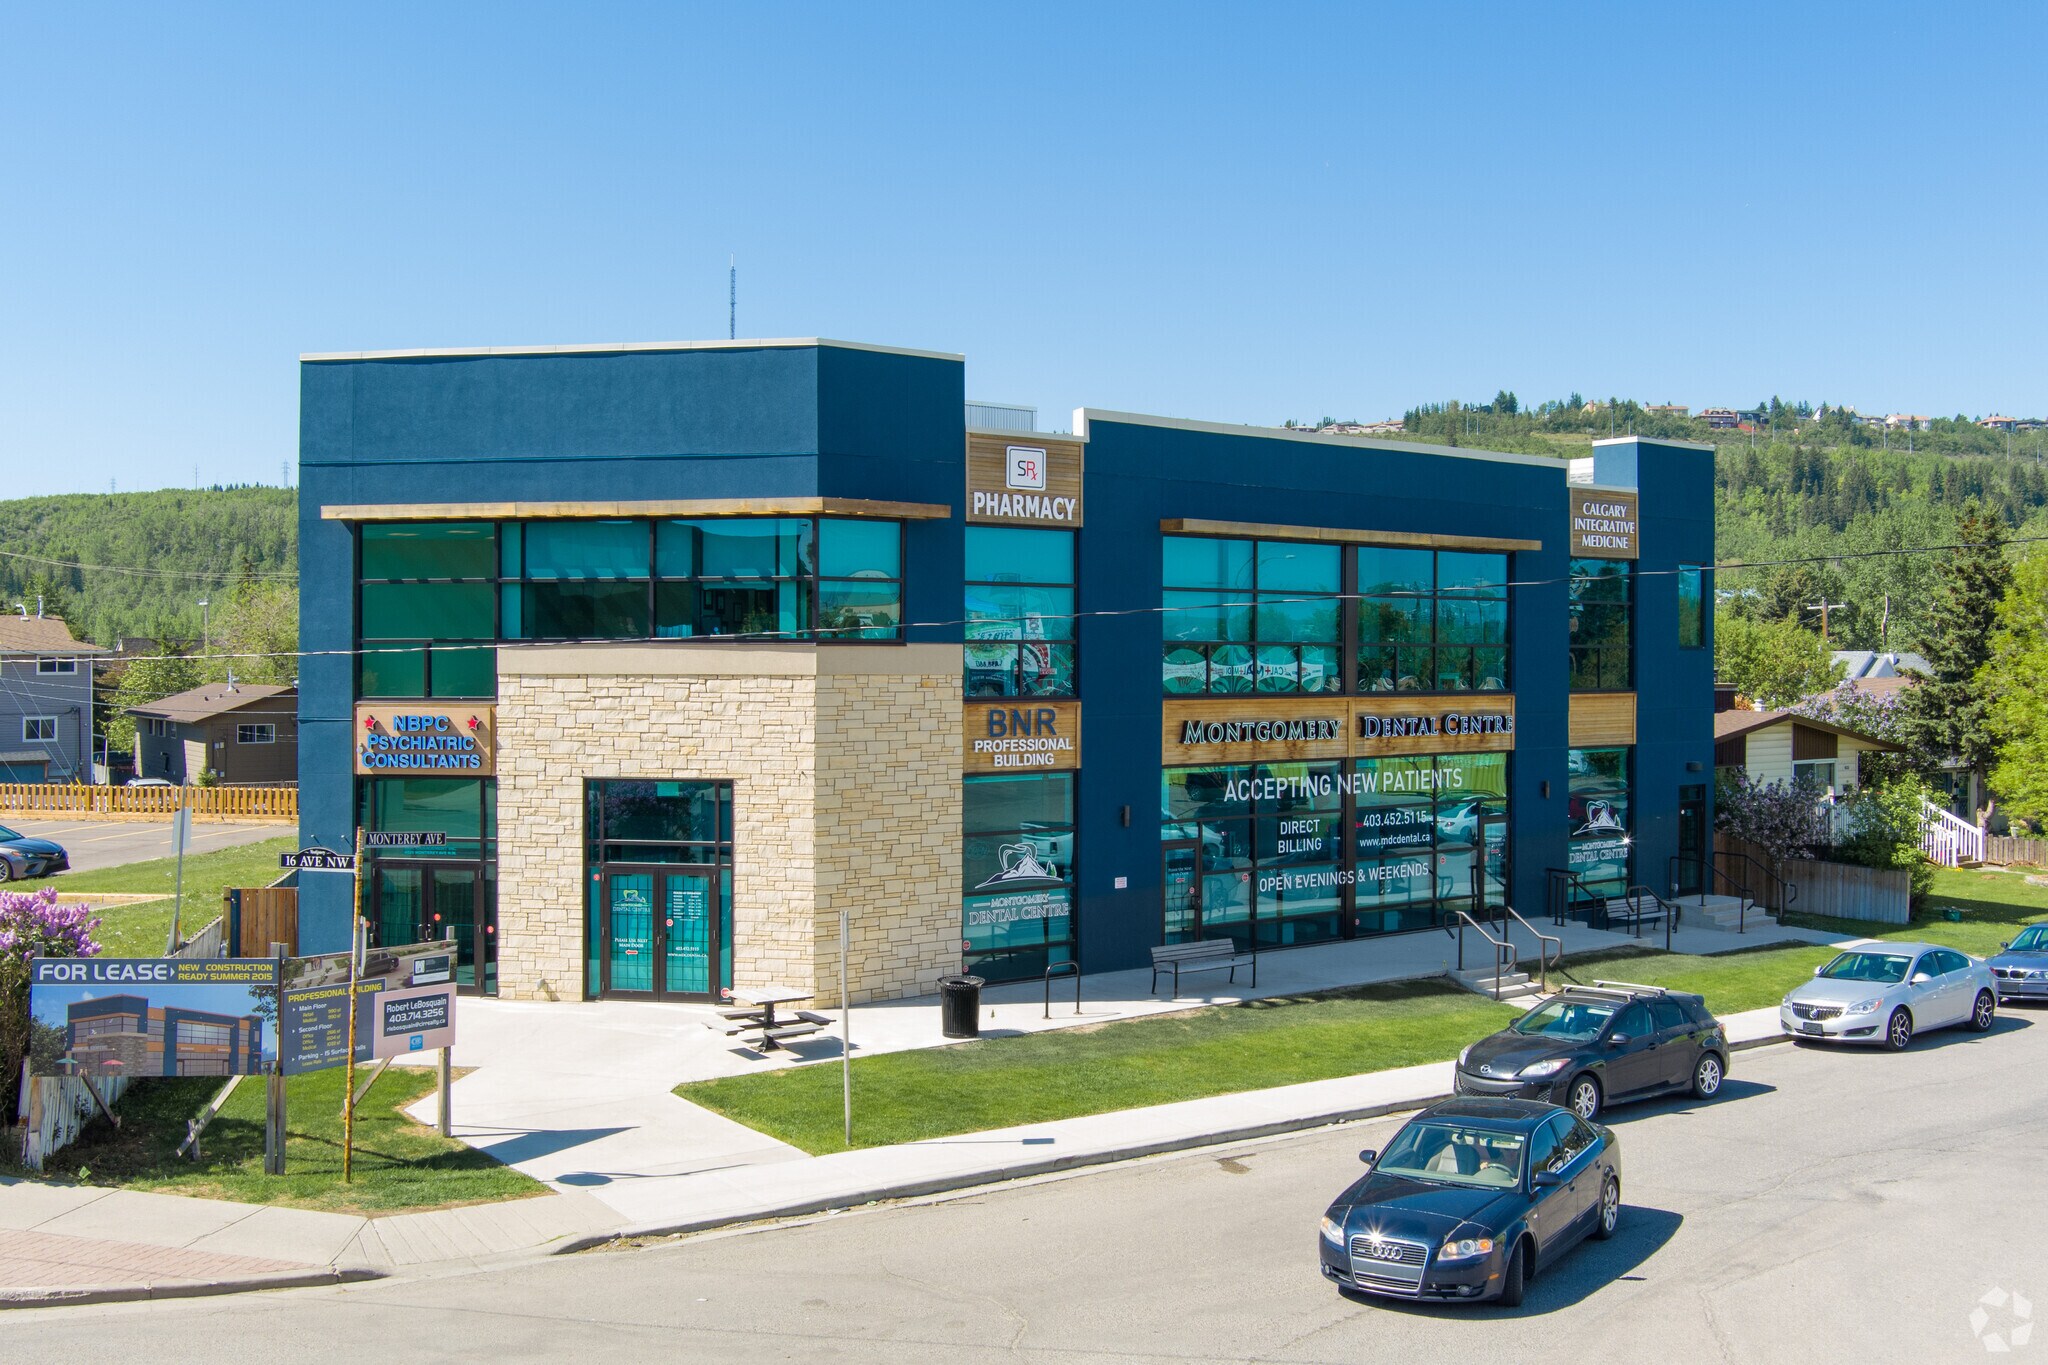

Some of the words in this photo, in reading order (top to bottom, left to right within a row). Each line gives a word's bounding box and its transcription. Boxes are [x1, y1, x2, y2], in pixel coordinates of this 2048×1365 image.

[973, 491, 1076, 520] PHARMACY
[1583, 502, 1627, 517] CALGARY
[1574, 518, 1635, 534] INTEGRATIVE
[1582, 534, 1628, 548] MEDICINE
[393, 715, 449, 732] NBPC
[988, 708, 1056, 738] BNR
[1184, 720, 1342, 744] MONTGOMERY
[1364, 716, 1440, 738] DENTAL
[1445, 713, 1513, 735] CENTRE
[367, 734, 475, 750] PSYCHIATRIC
[974, 738, 1073, 752] PROFESSIONAL
[362, 752, 481, 769] CONSULTANTS
[994, 753, 1054, 767] BUILDING
[1224, 774, 1331, 802] ACCEPTING
[1338, 772, 1378, 795] NEW
[1383, 768, 1462, 792] PATIENTS
[1363, 810, 1426, 828] 403.452.5115
[1280, 820, 1320, 835] DIRECT
[368, 834, 422, 845] MONTEREY
[425, 833, 442, 845] AVE
[1278, 838, 1322, 854] BILLING
[1360, 833, 1430, 848] www.mdcdental.ca
[286, 855, 296, 866] 16
[300, 856, 323, 867] AVE
[326, 857, 349, 868] NW
[1569, 850, 1598, 864] DENTAL
[1600, 848, 1628, 860] CENTRE
[1259, 876, 1292, 892] OPEN
[1296, 870, 1354, 888] EVENINGS
[1358, 870, 1366, 882] &
[1368, 862, 1429, 880] WEEKENDS
[990, 894, 1050, 907] MONTGOMERY
[969, 907, 1018, 926] DENTAL
[1020, 903, 1069, 920] CENTRE
[39, 964, 86, 980] FOR
[94, 964, 168, 980] LEASE
[178, 973, 208, 981] READY
[210, 973, 250, 981] SUMMER
[251, 973, 273, 981] 2015
[288, 988, 347, 1002] PROFESSIONAL
[386, 1003, 409, 1013] Robert
[411, 998, 447, 1011] LeBosquain
[389, 1008, 444, 1023] 403.714.3256
[299, 1025, 317, 1033] Second
